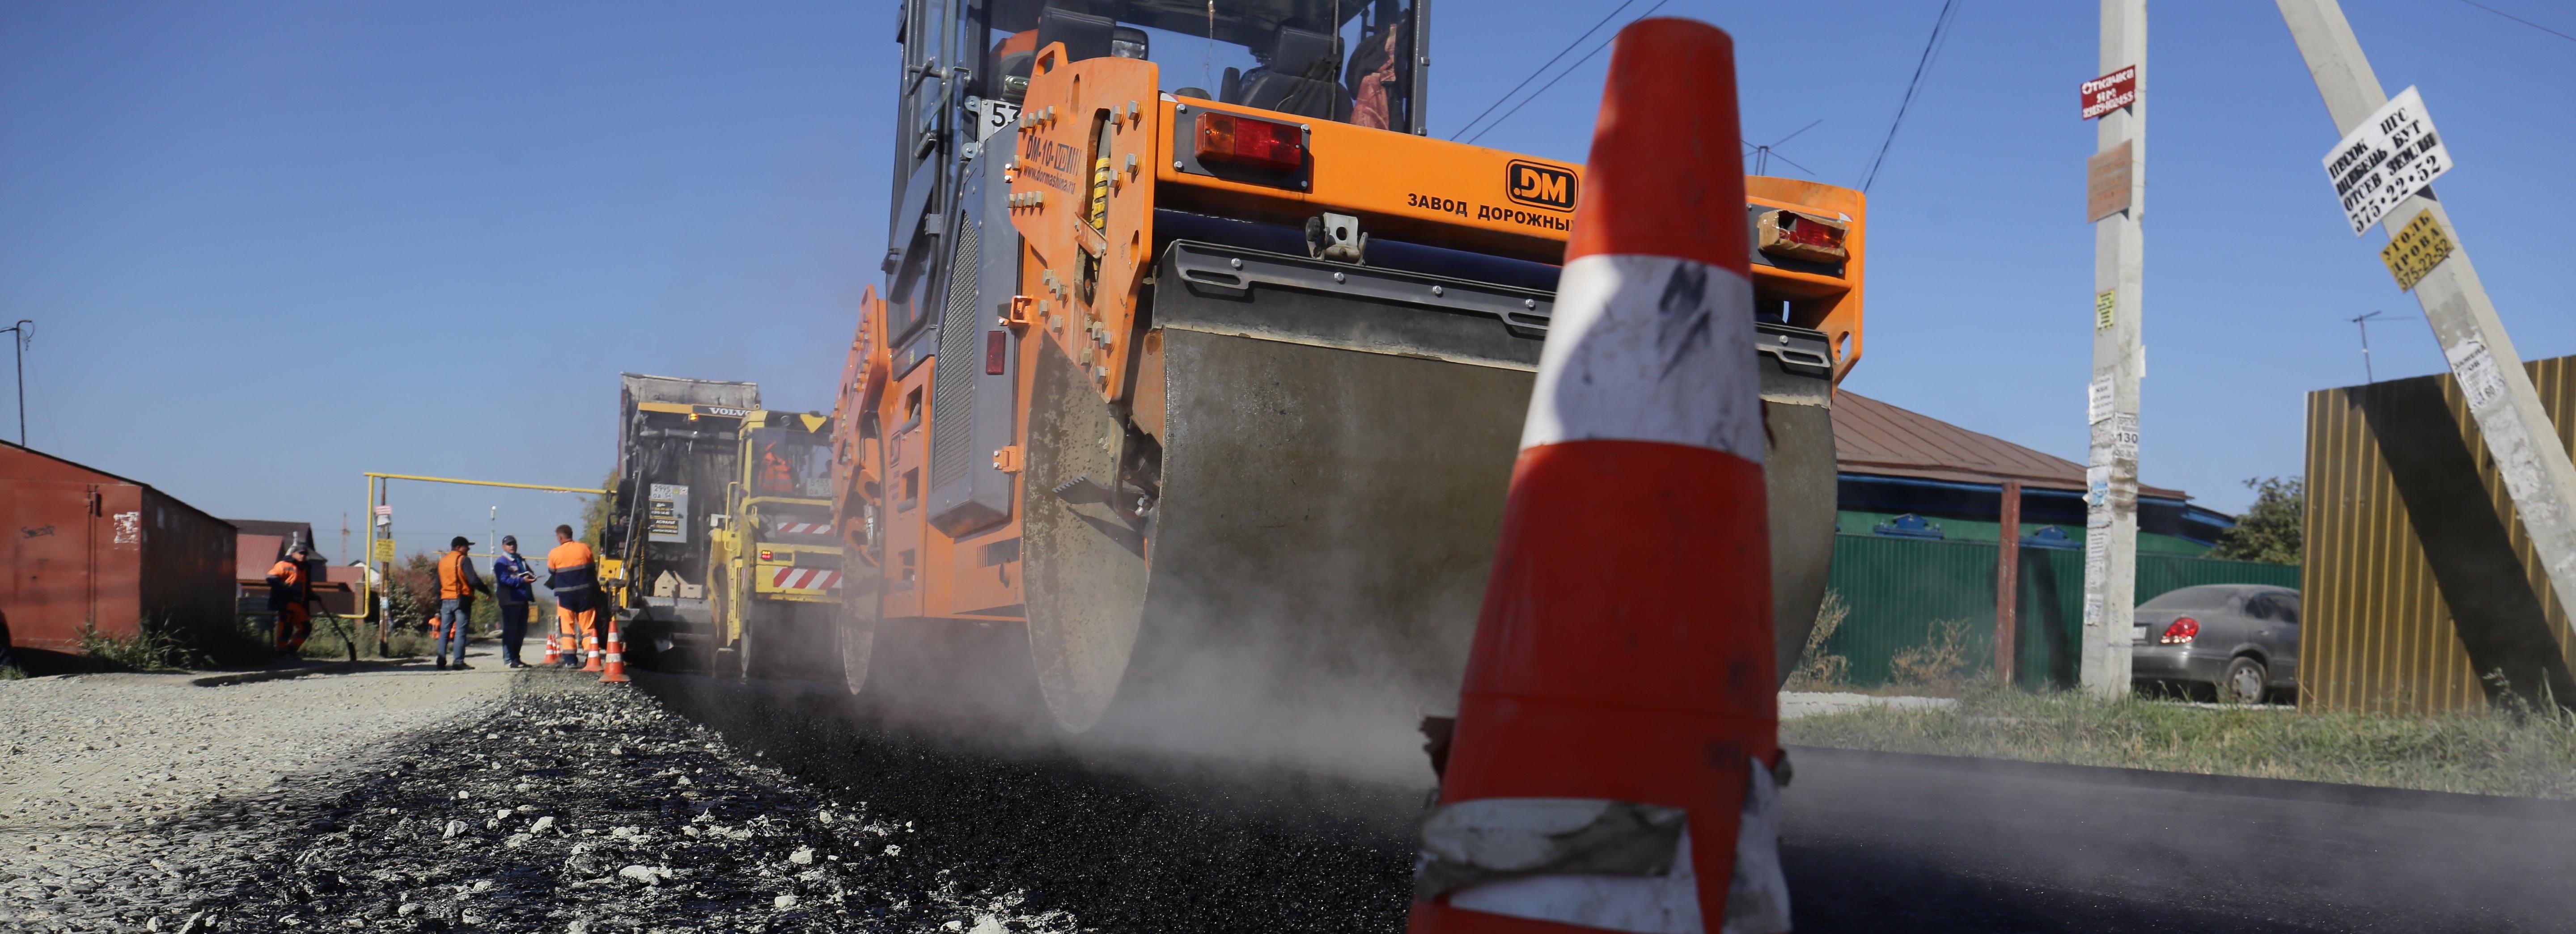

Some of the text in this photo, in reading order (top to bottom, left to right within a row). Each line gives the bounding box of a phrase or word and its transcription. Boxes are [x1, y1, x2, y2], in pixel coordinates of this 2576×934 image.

[2329, 107, 2409, 179] ПЕСОК ПГС
[2336, 120, 2421, 197] ЩЕБЕНЬ БУТ
[1023, 165, 1076, 195] www.dormashina.ru
[2344, 173, 2382, 211] ОТСЕВ
[1407, 193, 1574, 232] ЗАВОД ДОРОЖНЫ
[2383, 217, 2430, 260] УГОЛЬ
[2392, 228, 2440, 276] ДРОВА
[2398, 239, 2449, 290] 375-22-52
[2117, 432, 2138, 444] 130
